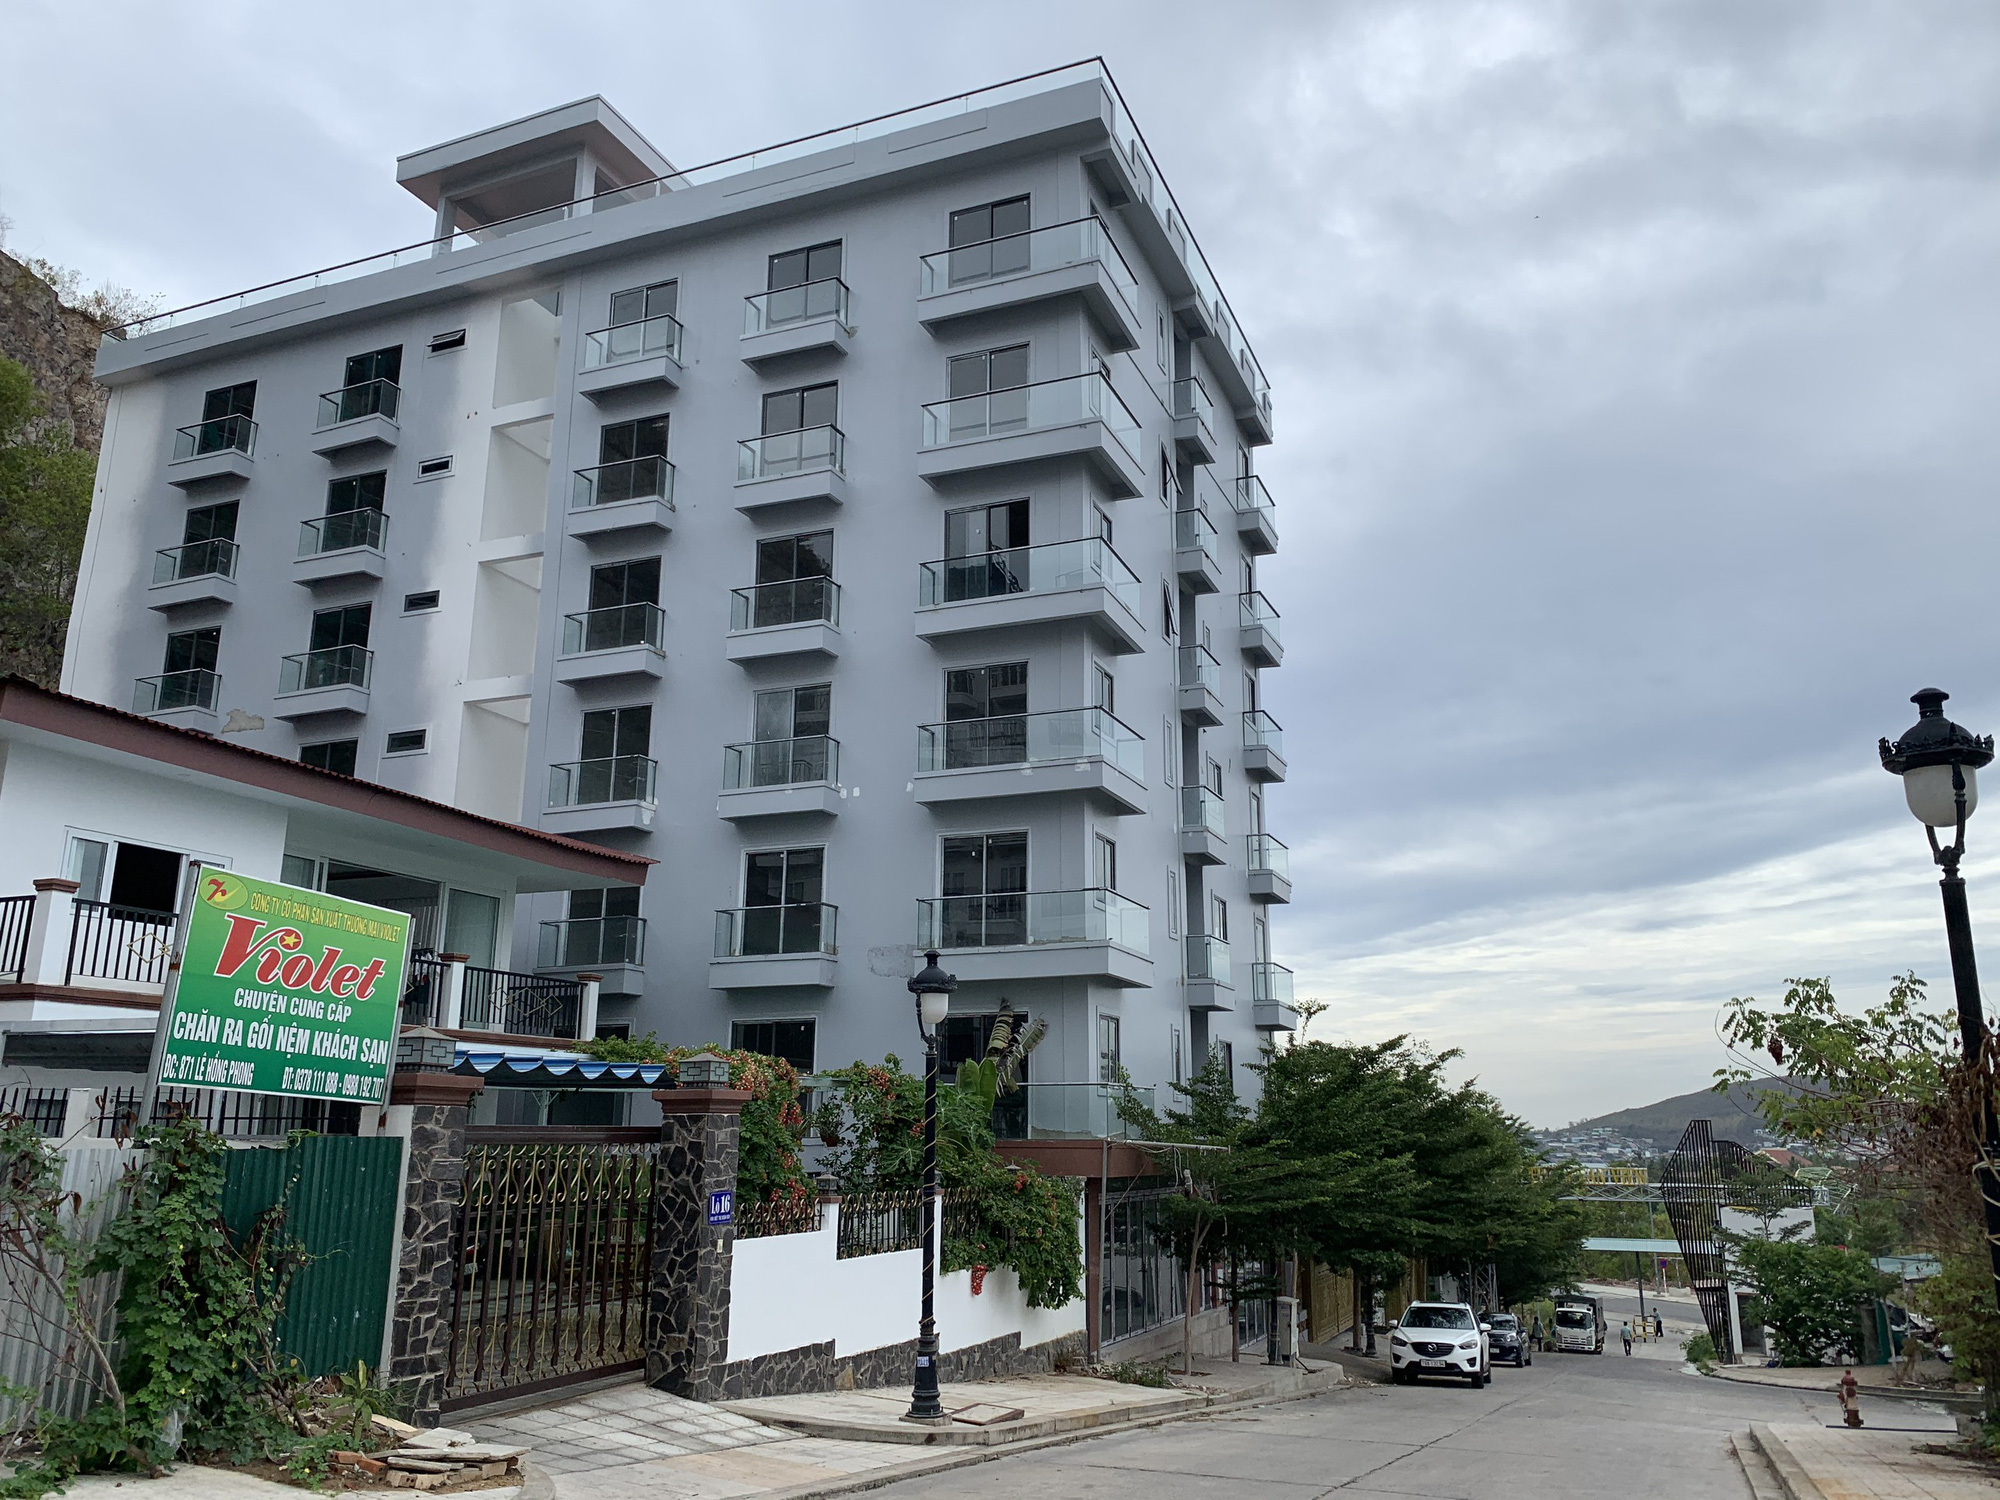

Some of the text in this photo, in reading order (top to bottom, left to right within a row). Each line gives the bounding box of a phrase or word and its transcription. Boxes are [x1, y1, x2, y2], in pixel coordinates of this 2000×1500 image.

[250, 888, 270, 913] CÔNG
[271, 896, 281, 915] TY
[291, 896, 311, 922] PHẦN
[311, 901, 325, 926] SẢN
[325, 905, 343, 930] XUẤT
[368, 919, 380, 942] MẠI
[380, 922, 402, 943] VIOLET
[213, 912, 386, 1001] Violet
[233, 987, 352, 1023] CHUYÊN CUNG CẤP
[173, 1008, 389, 1069] CHĂN RA GỐI NỆM KHÁCH SẠN
[178, 1055, 194, 1080] 871
[194, 1052, 207, 1081] LÊ
[227, 1060, 255, 1086] PHONG
[294, 1068, 313, 1092] 0378
[312, 1069, 326, 1093] 111
[325, 1071, 339, 1094] 888
[359, 1075, 372, 1098] 192
[371, 1077, 385, 1099] 707
[720, 1194, 730, 1213] 16
